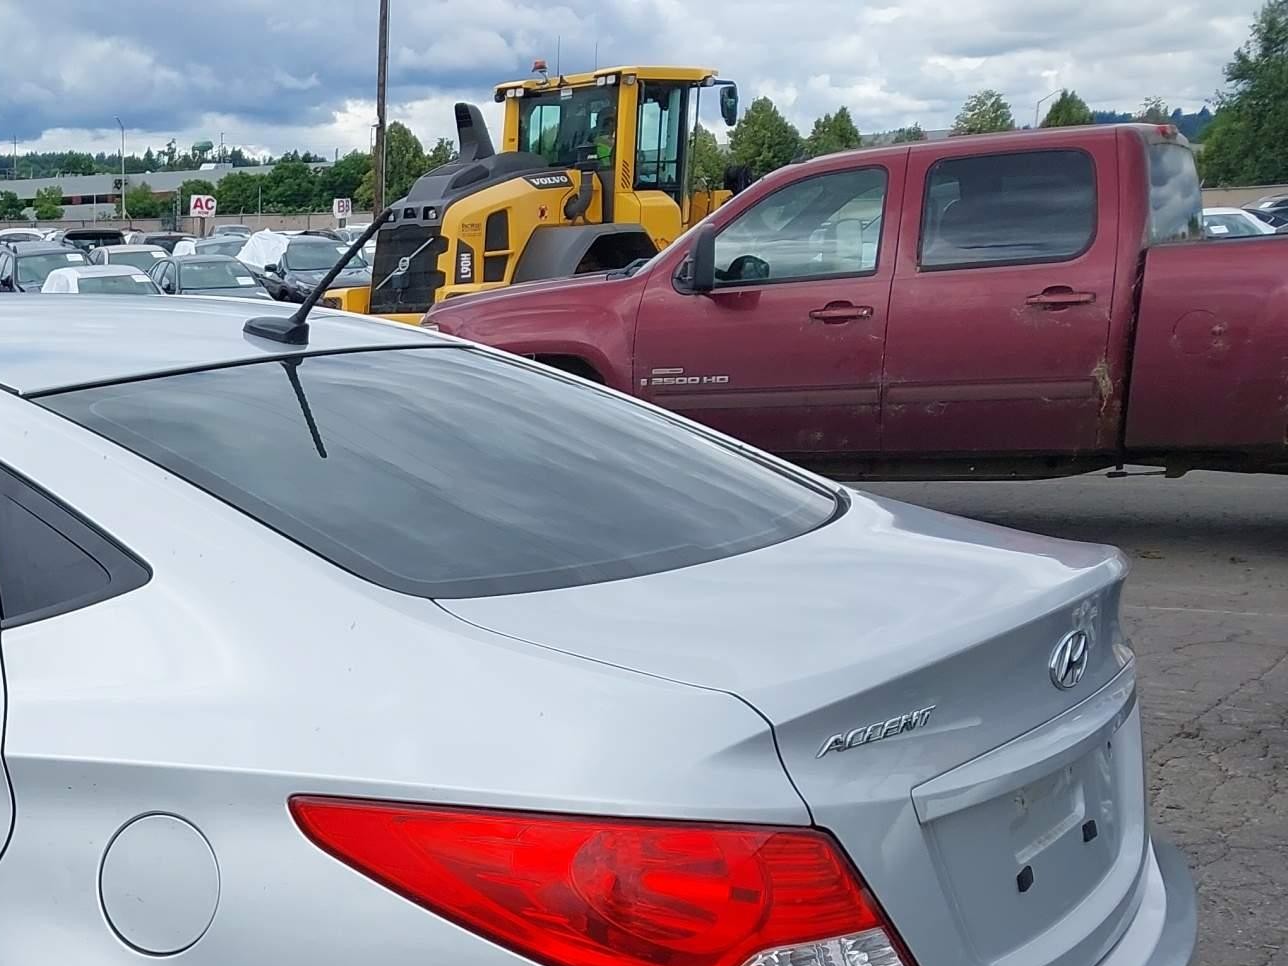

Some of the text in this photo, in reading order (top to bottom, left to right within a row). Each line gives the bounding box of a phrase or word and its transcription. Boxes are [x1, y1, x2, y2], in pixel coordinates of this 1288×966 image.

[530, 175, 568, 186] VOLVO
[192, 197, 215, 211] AC
[460, 252, 472, 279] L90H
[651, 375, 729, 385] 2500 HD
[816, 704, 936, 759] ACCENT
